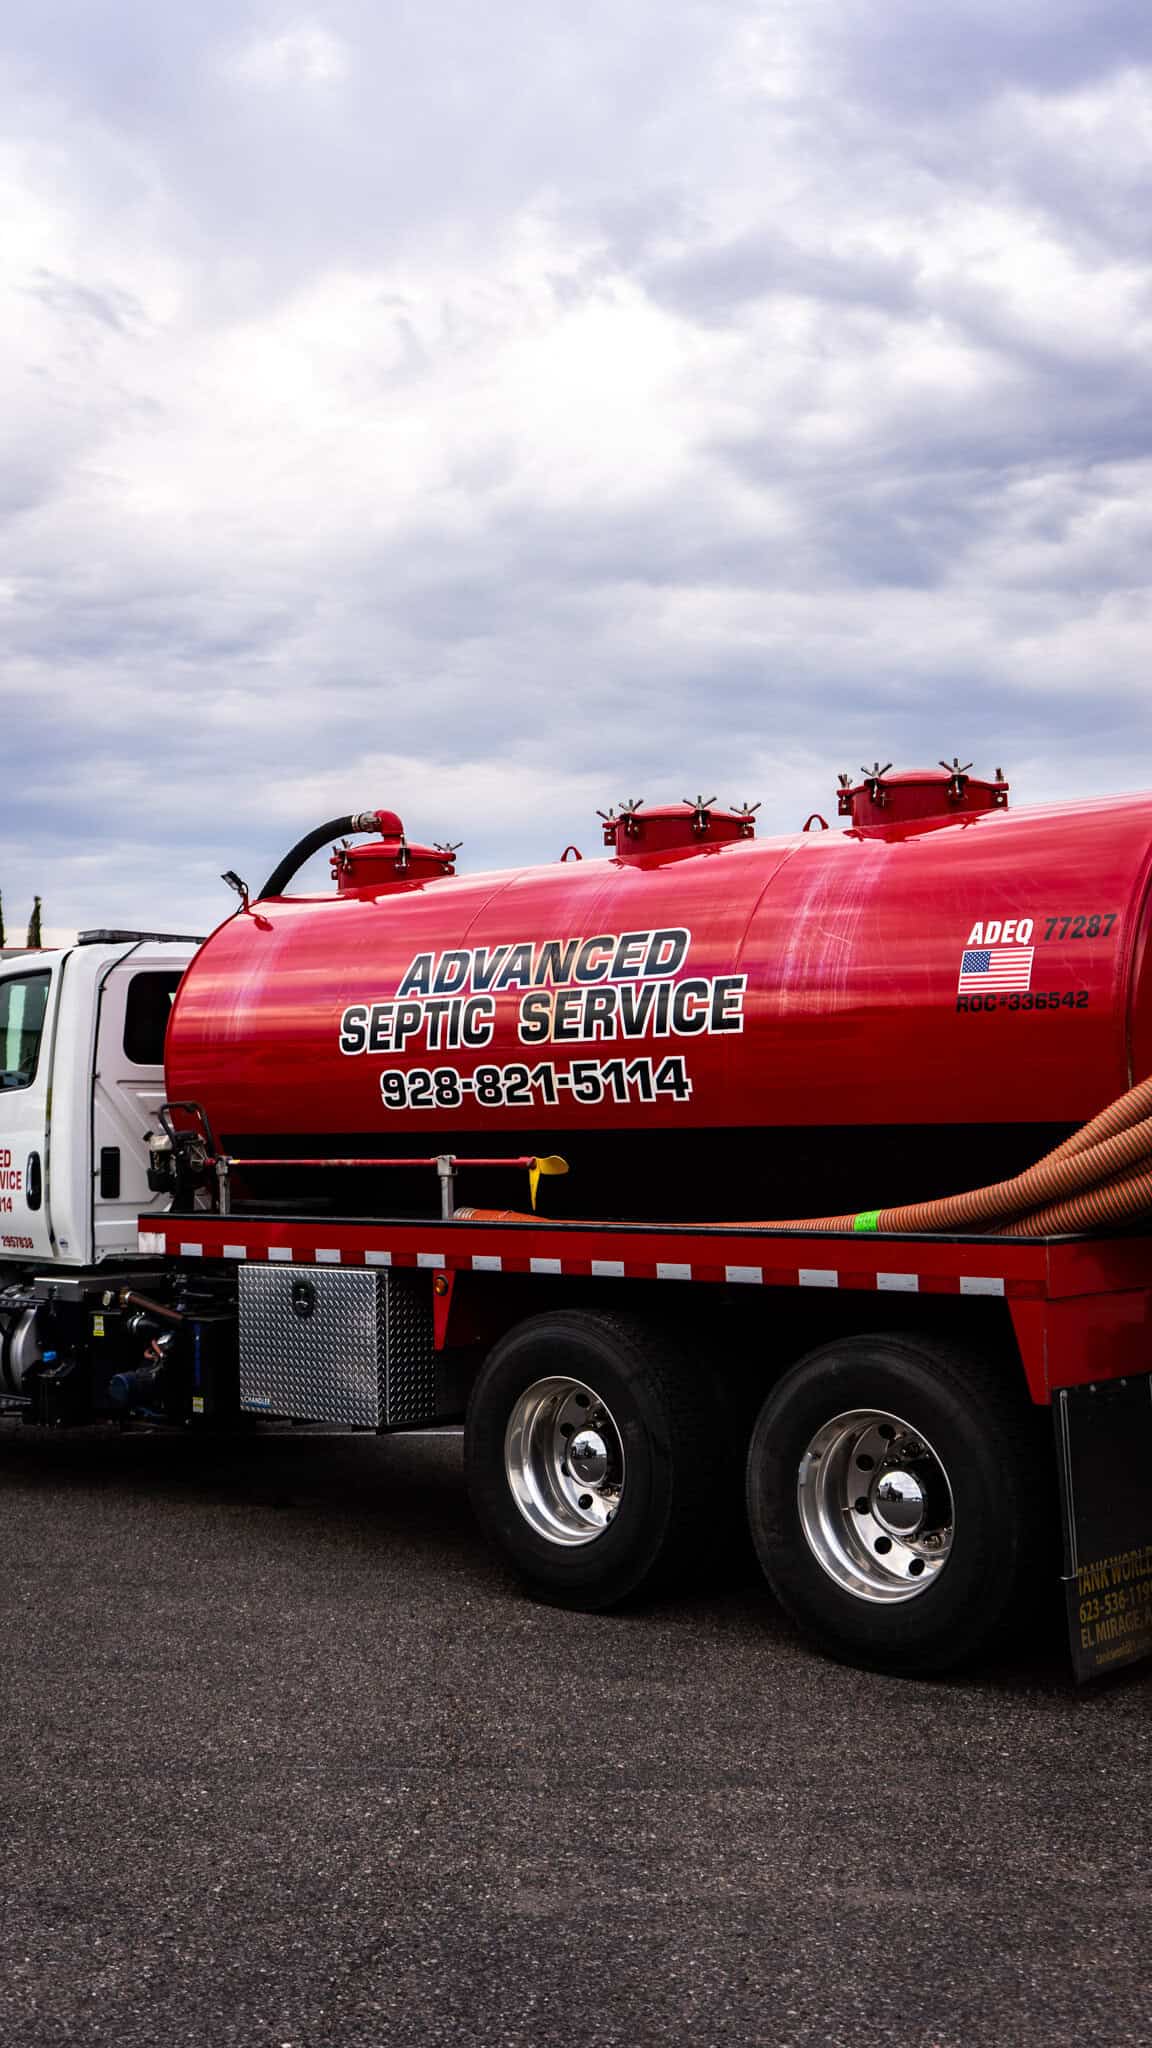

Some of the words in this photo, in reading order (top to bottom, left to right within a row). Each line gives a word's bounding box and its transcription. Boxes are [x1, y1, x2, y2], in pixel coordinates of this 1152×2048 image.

[967, 918, 1034, 946] ADEQ
[1044, 913, 1118, 941] 77287
[396, 927, 691, 999] ADVANCED
[339, 995, 496, 1055] SEPTIC
[518, 974, 748, 1045] SERVICE
[380, 1056, 692, 1110] 928-821-5114
